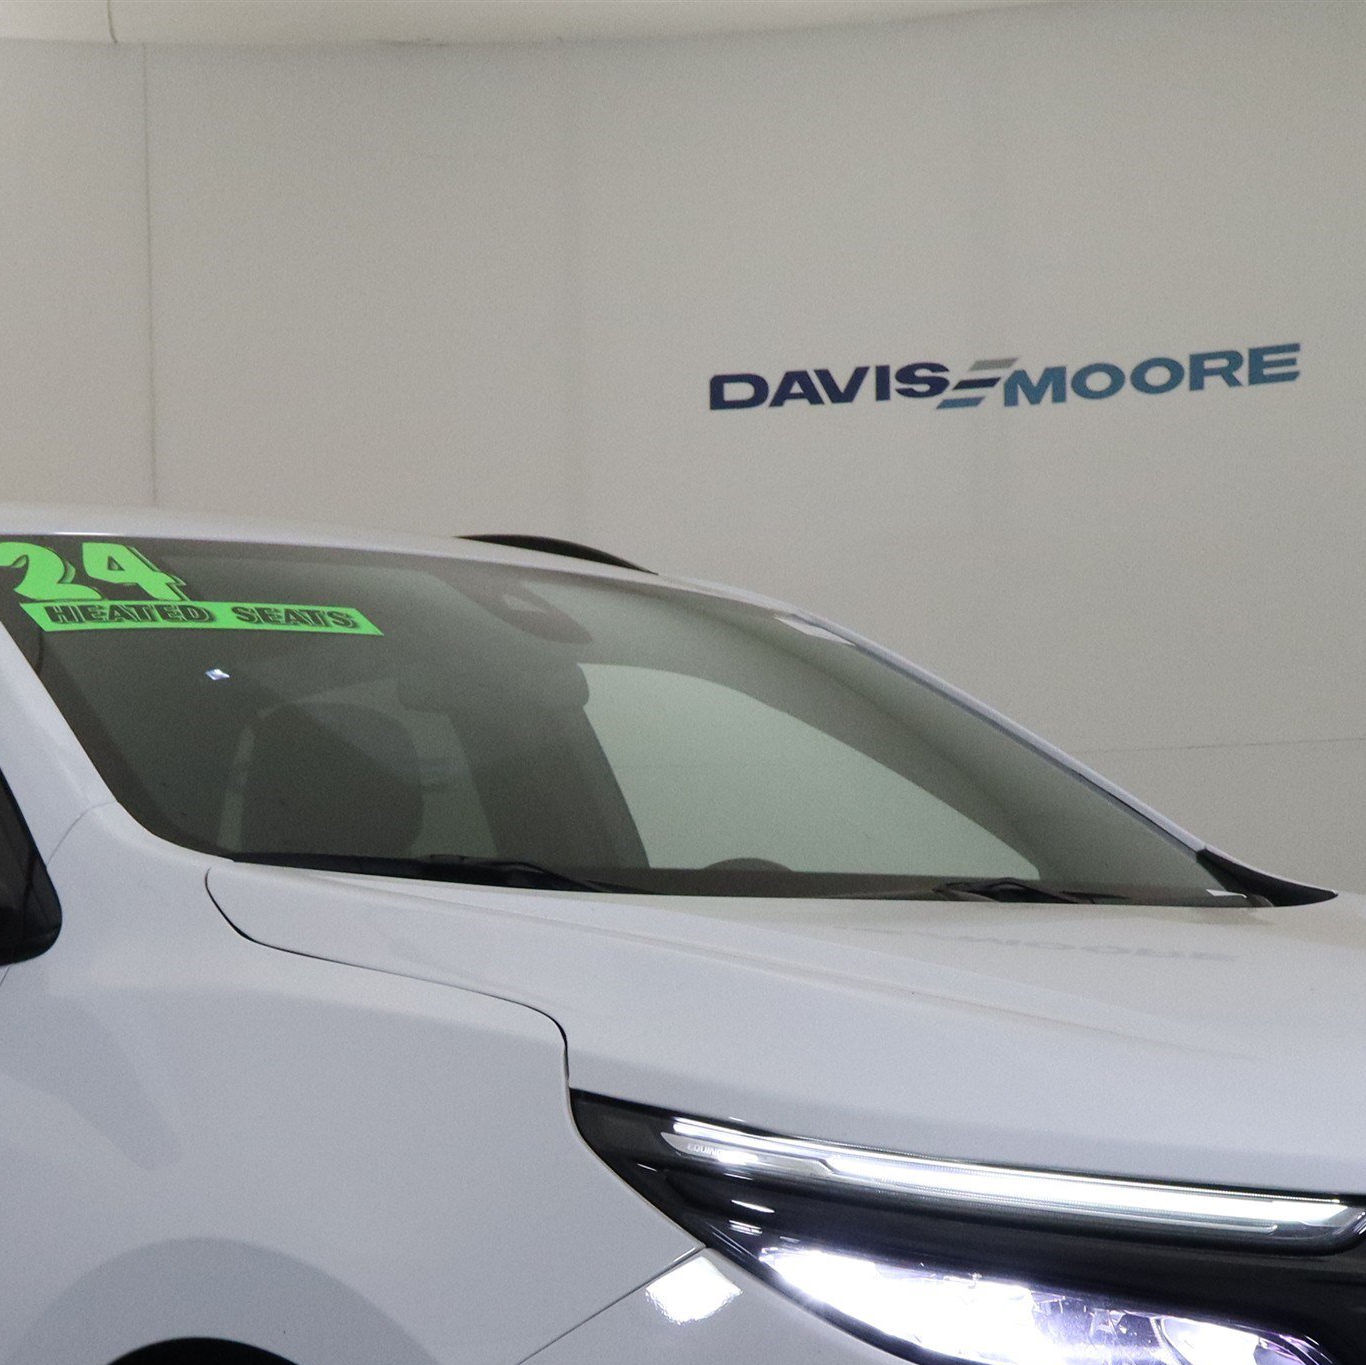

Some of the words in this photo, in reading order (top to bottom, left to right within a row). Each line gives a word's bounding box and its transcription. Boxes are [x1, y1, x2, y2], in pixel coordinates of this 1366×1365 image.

[709, 361, 950, 411] DAVIS
[1003, 342, 1301, 408] MOORE
[44, 603, 217, 625] HEATED
[230, 605, 361, 629] SEATS
